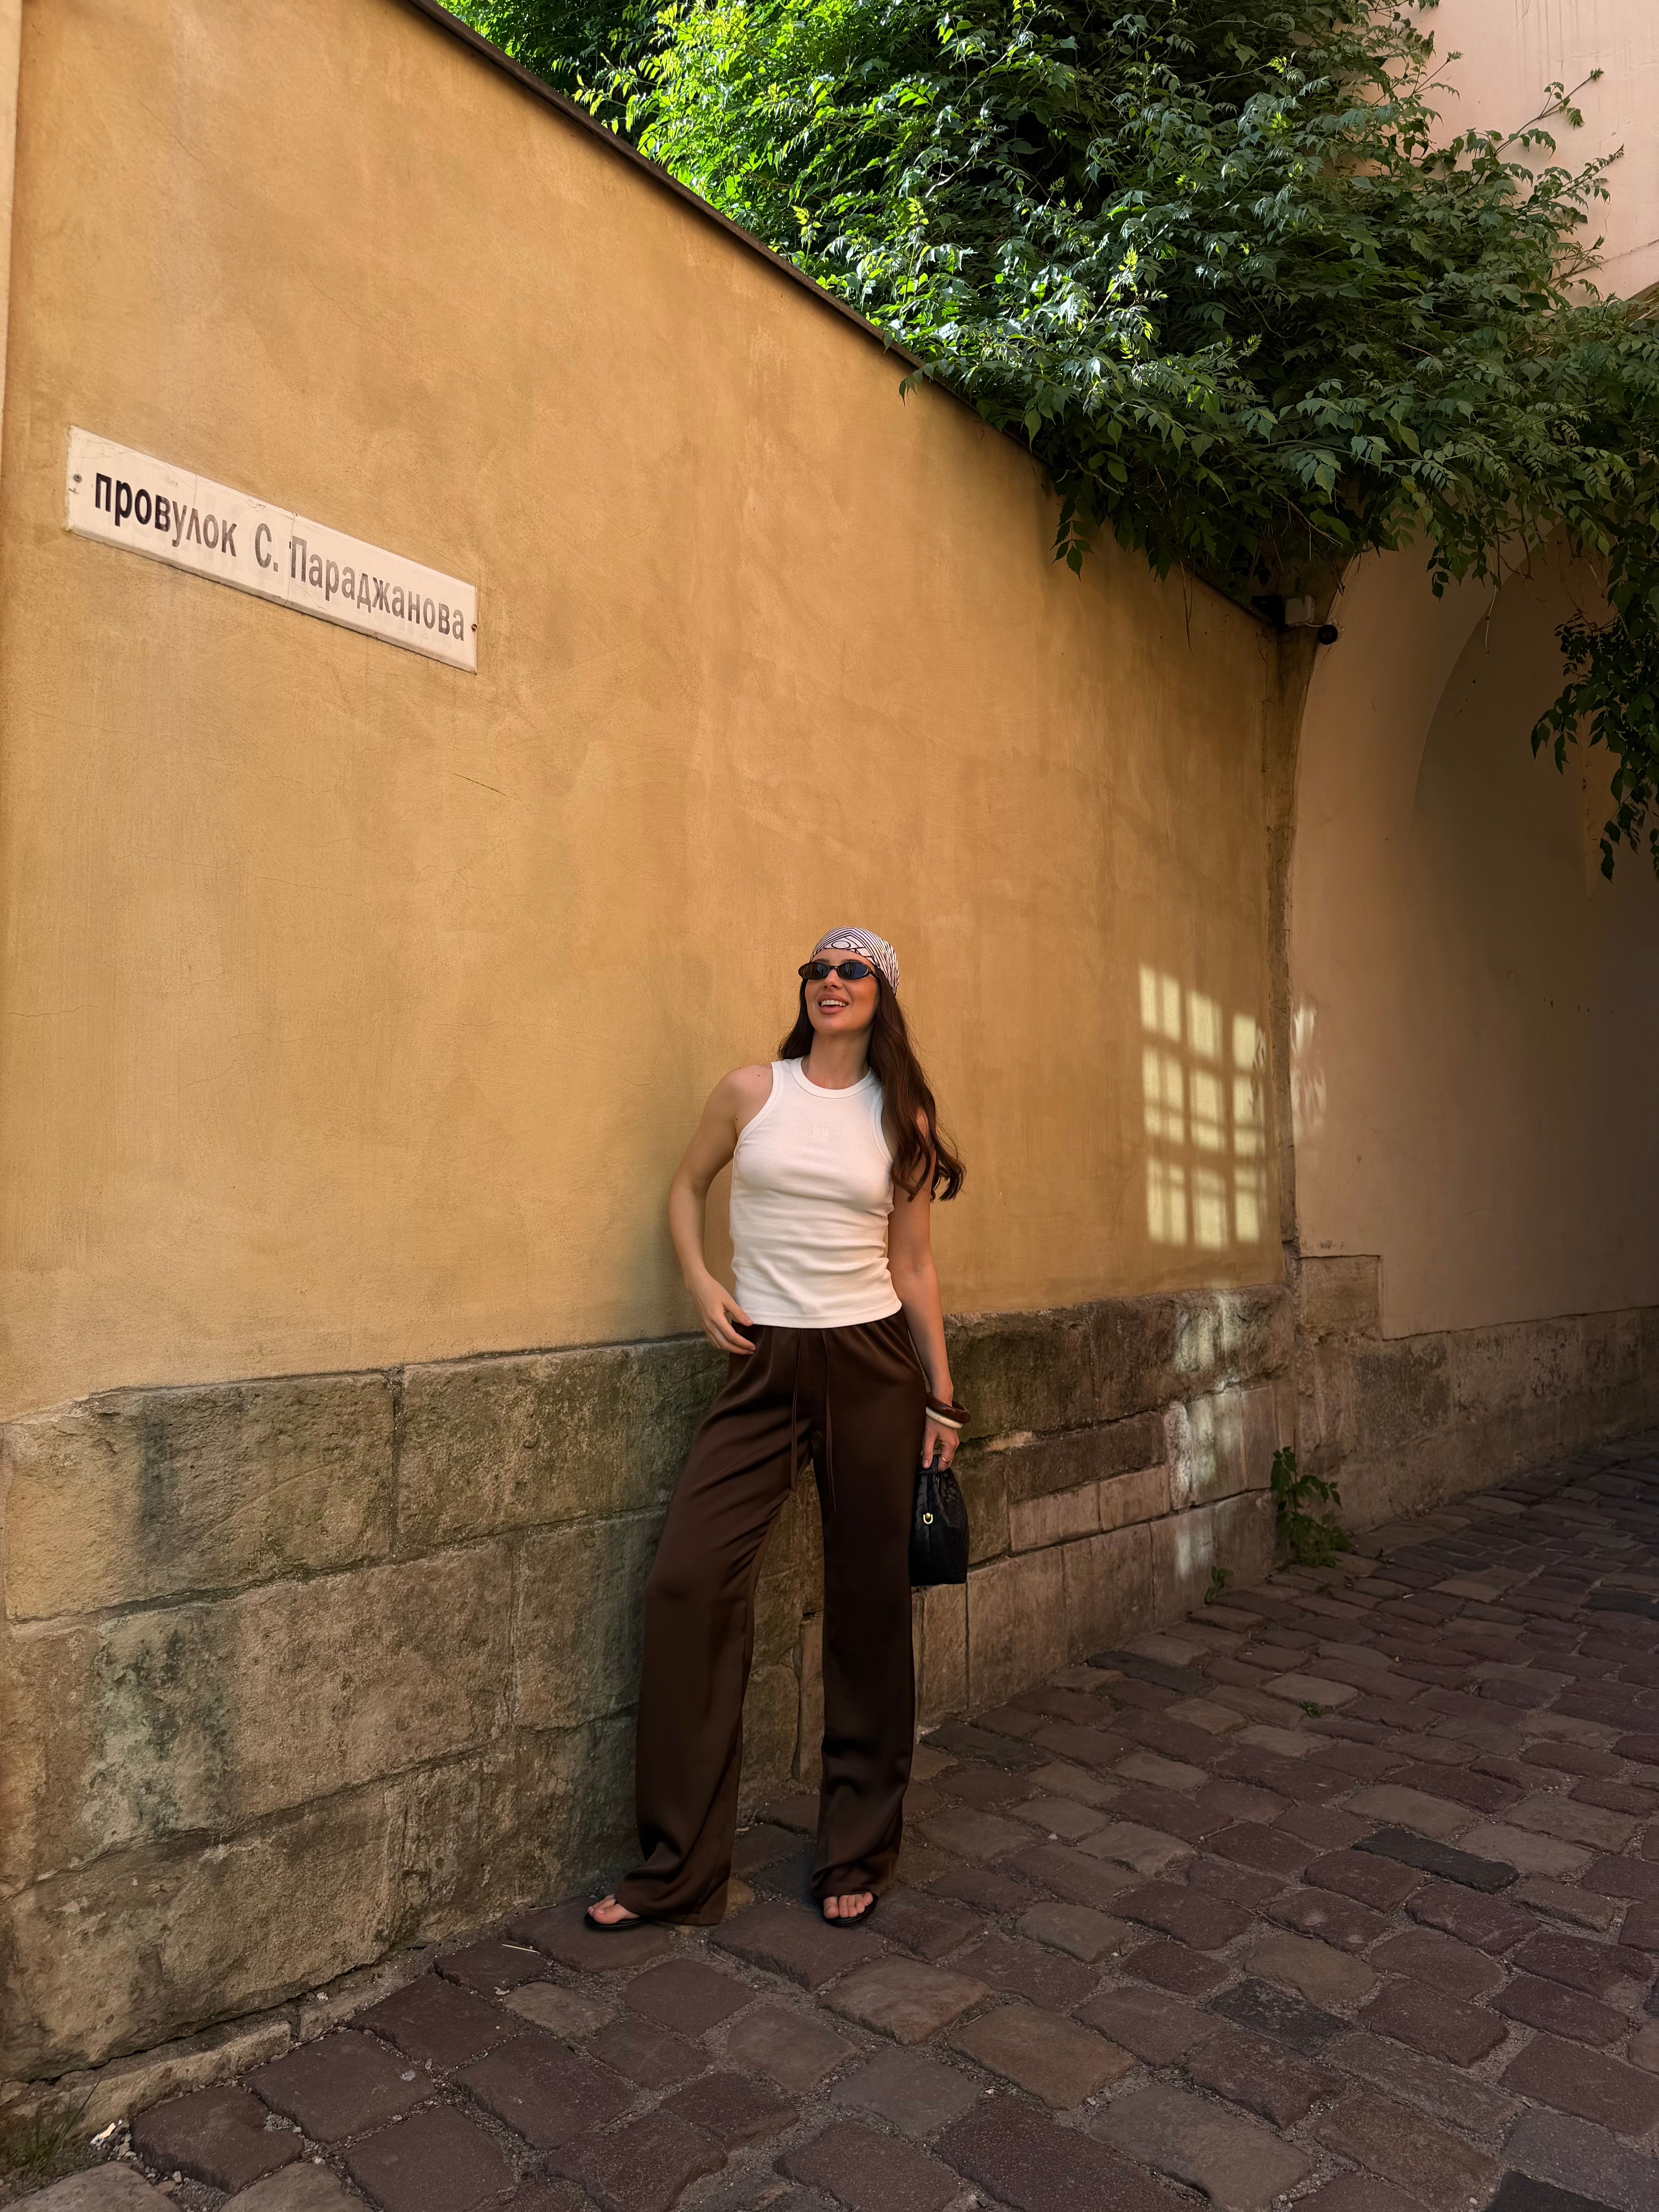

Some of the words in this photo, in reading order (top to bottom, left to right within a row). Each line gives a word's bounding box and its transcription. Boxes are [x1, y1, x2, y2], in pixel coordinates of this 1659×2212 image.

[95, 472, 237, 558] провулок
[255, 523, 278, 572] С.
[291, 535, 464, 642] Параджанова
